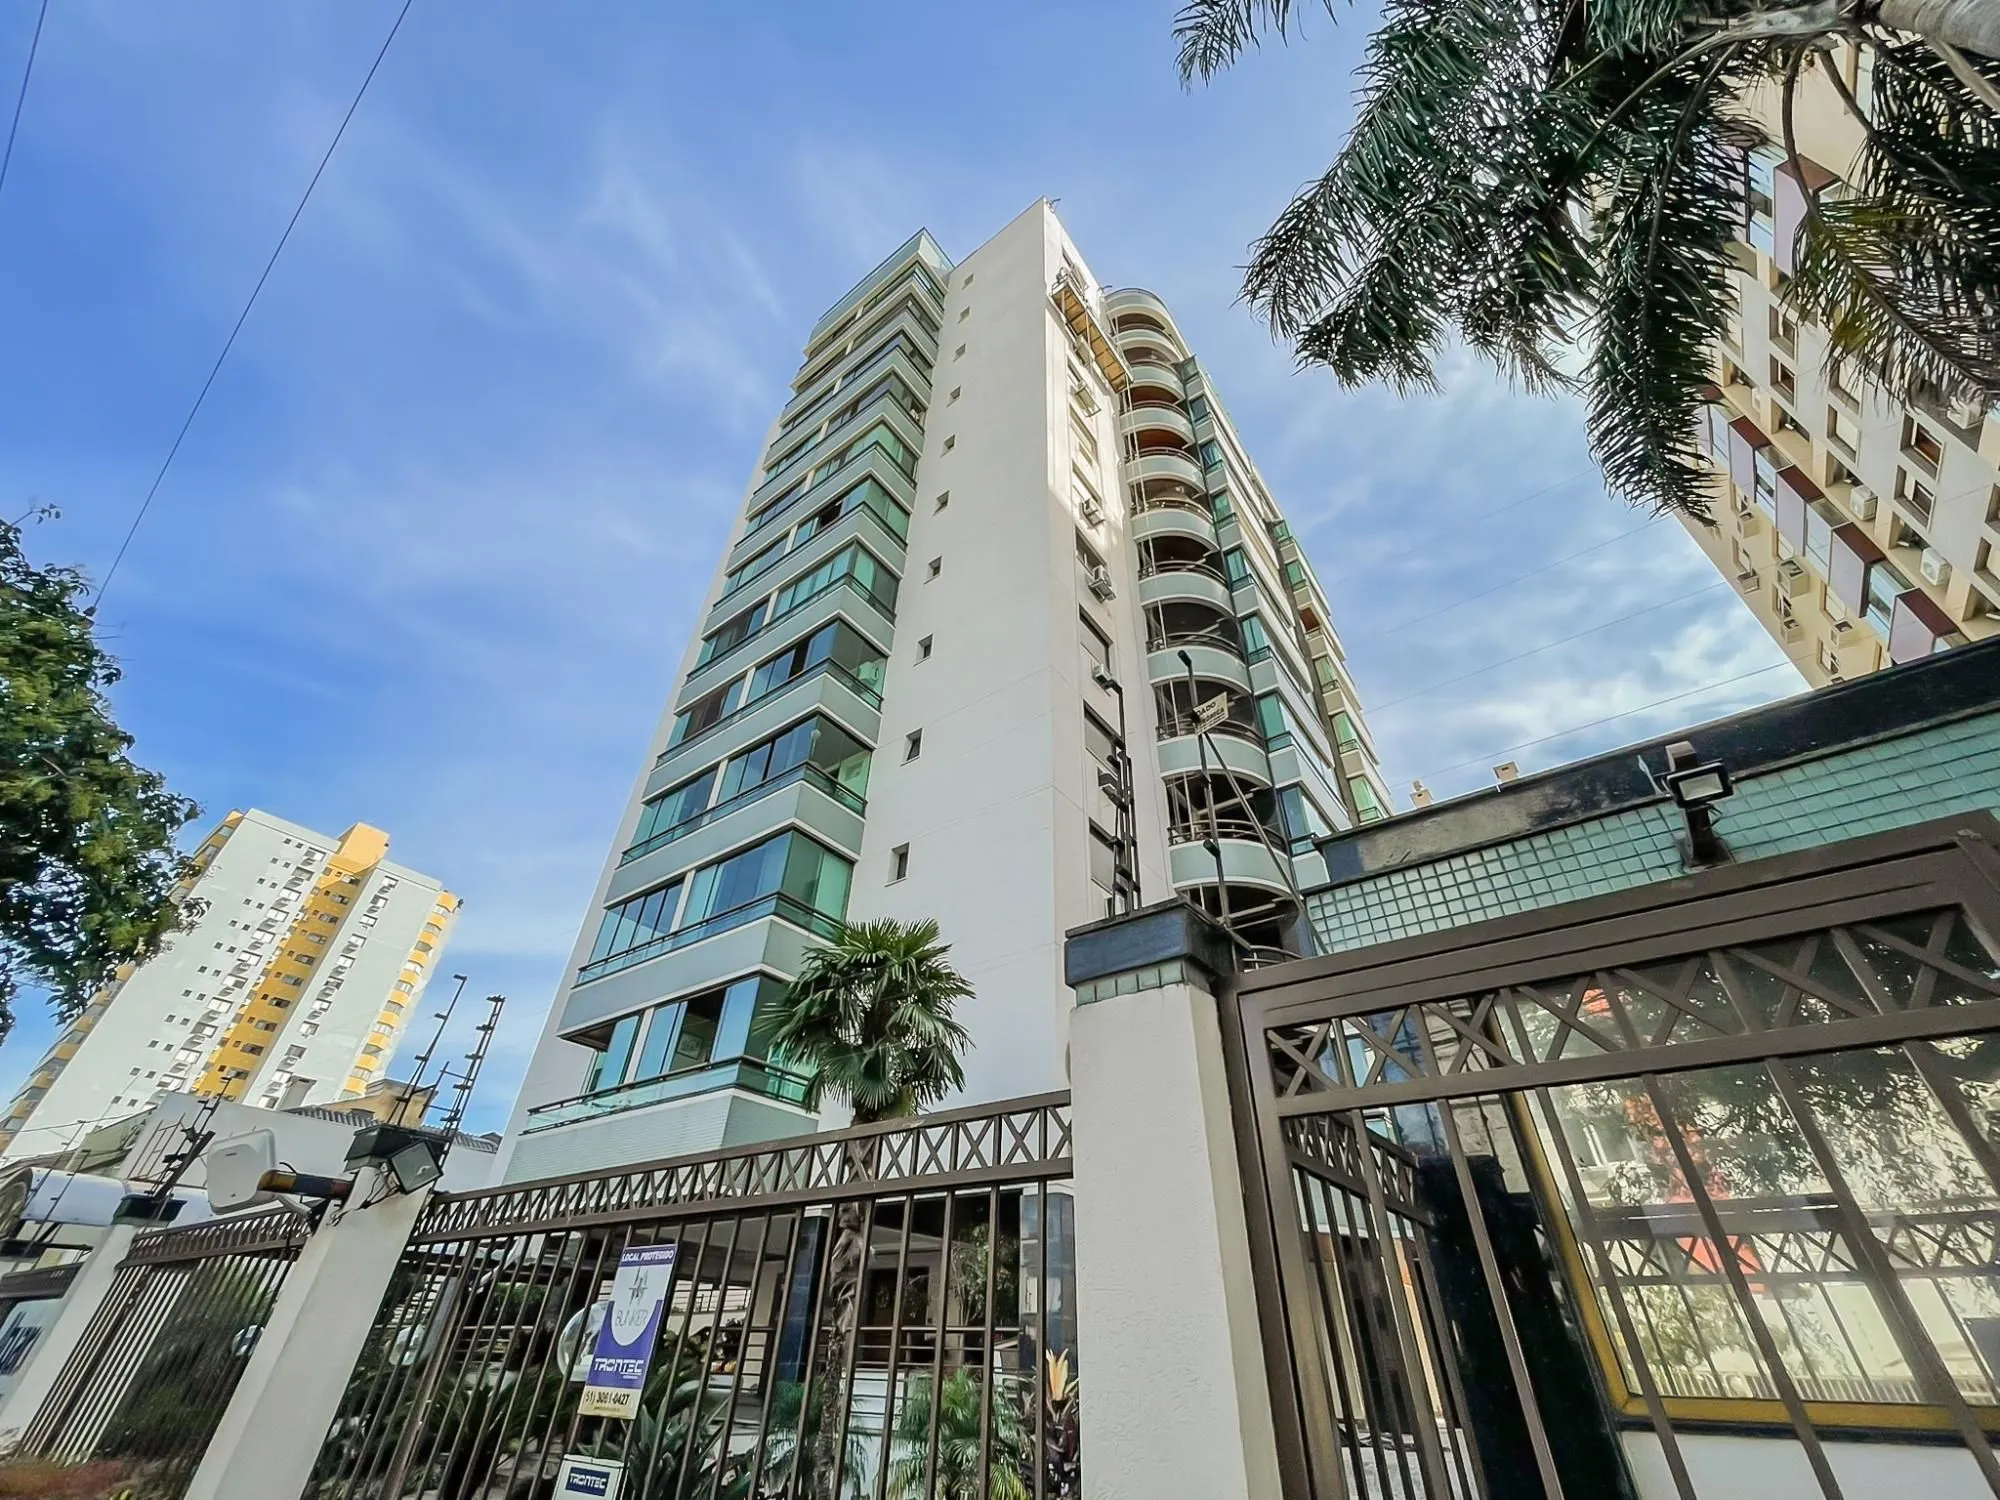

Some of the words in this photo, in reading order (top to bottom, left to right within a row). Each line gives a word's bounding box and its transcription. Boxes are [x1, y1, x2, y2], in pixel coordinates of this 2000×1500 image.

[621, 1252, 640, 1262] LOCAL
[640, 1249, 675, 1261] PROTEGIDO
[594, 1357, 644, 1373] TRONTEC
[569, 1473, 606, 1489] TRONTEC
